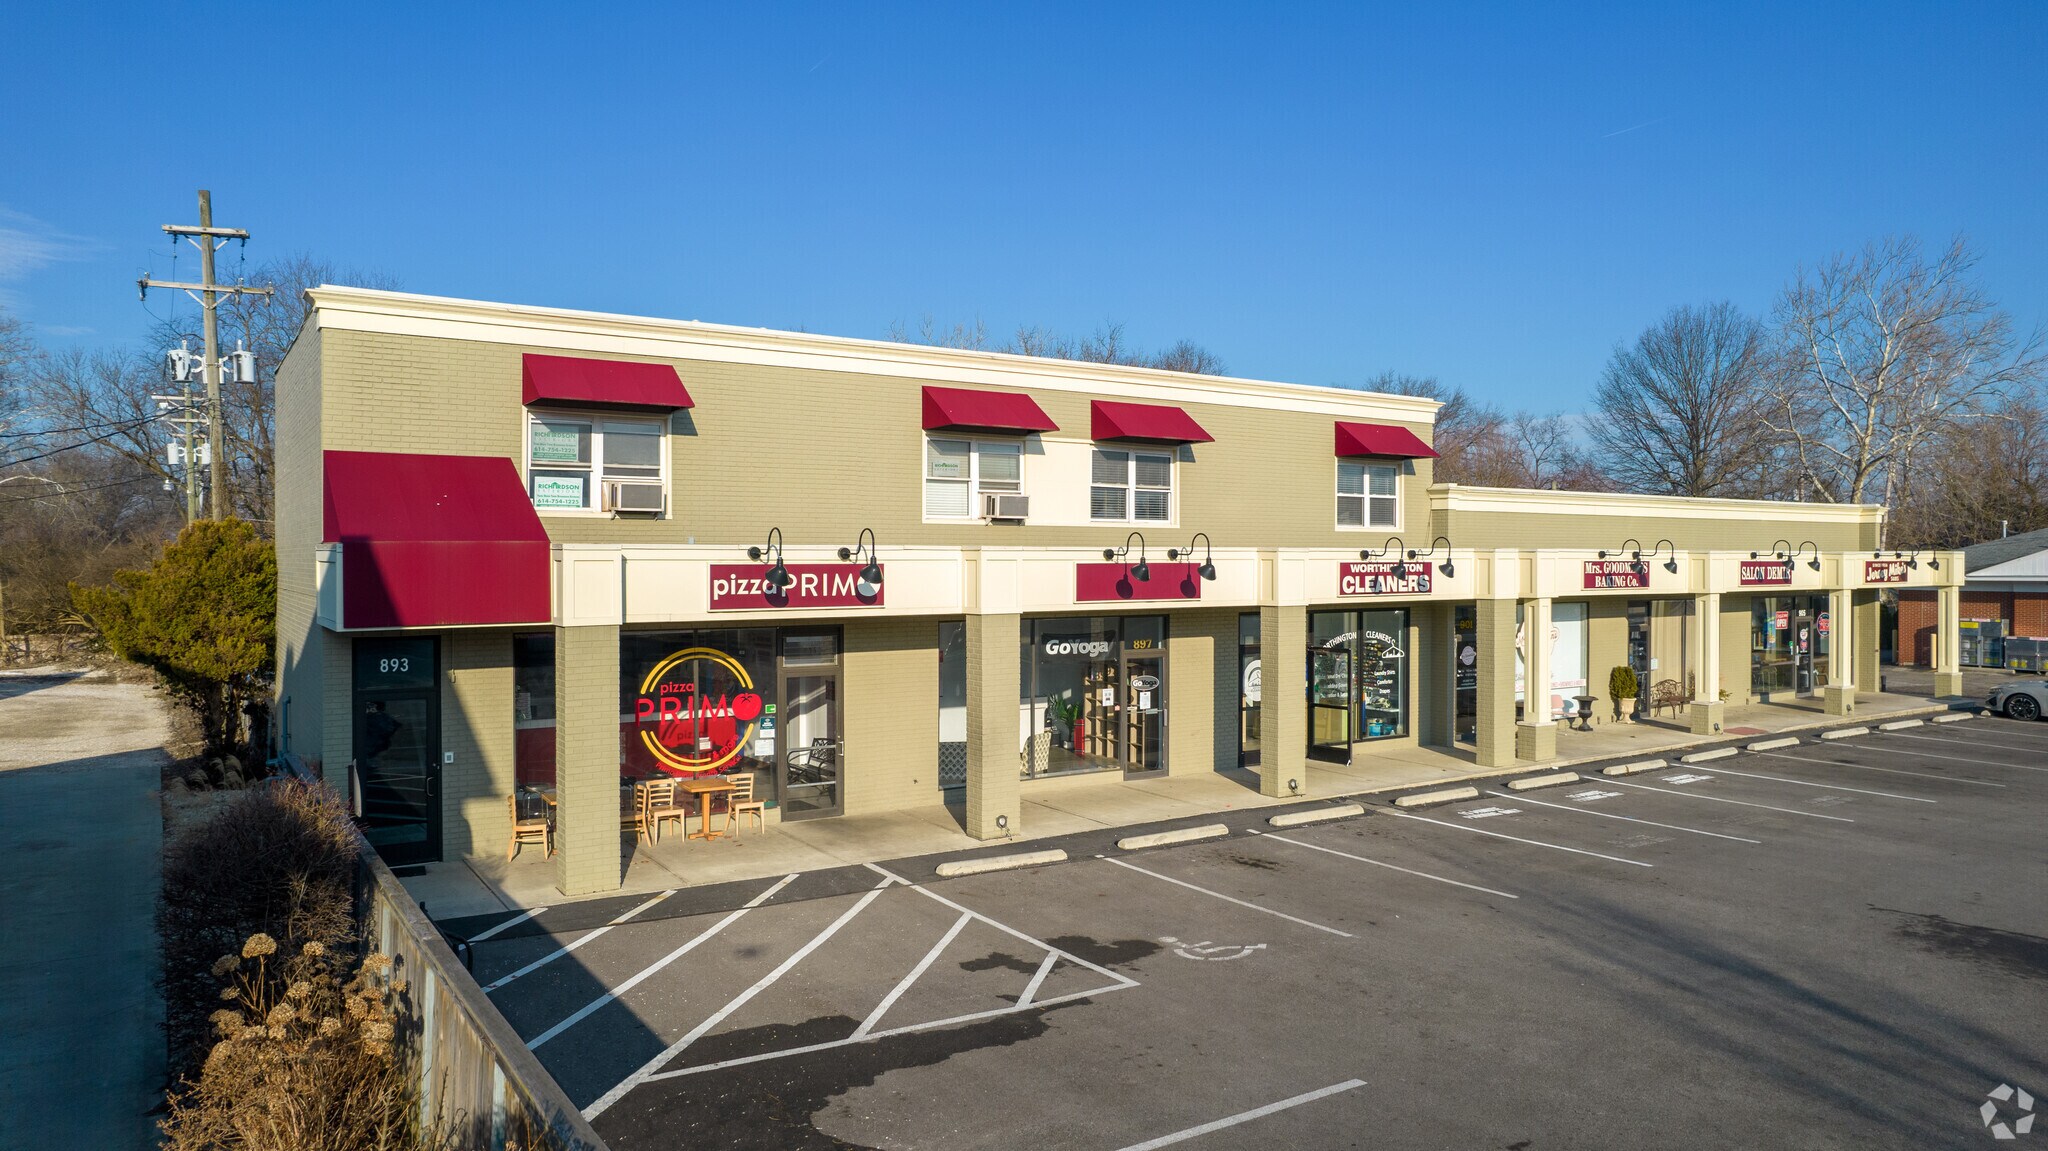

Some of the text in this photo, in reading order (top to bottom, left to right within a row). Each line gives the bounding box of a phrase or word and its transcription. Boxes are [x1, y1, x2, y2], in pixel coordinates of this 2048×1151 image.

[1350, 563, 1424, 573] WORTHITON
[1585, 562, 1602, 574] Mrs.
[1741, 566, 1765, 580] SALON
[1342, 574, 1430, 593] CLEANERS
[1595, 575, 1639, 588] BAKING Co.
[1365, 630, 1392, 643] CLEANERS
[1045, 639, 1109, 658] GoYoga
[1133, 639, 1152, 650] 897
[380, 658, 408, 672] 893
[660, 681, 695, 695] pizza
